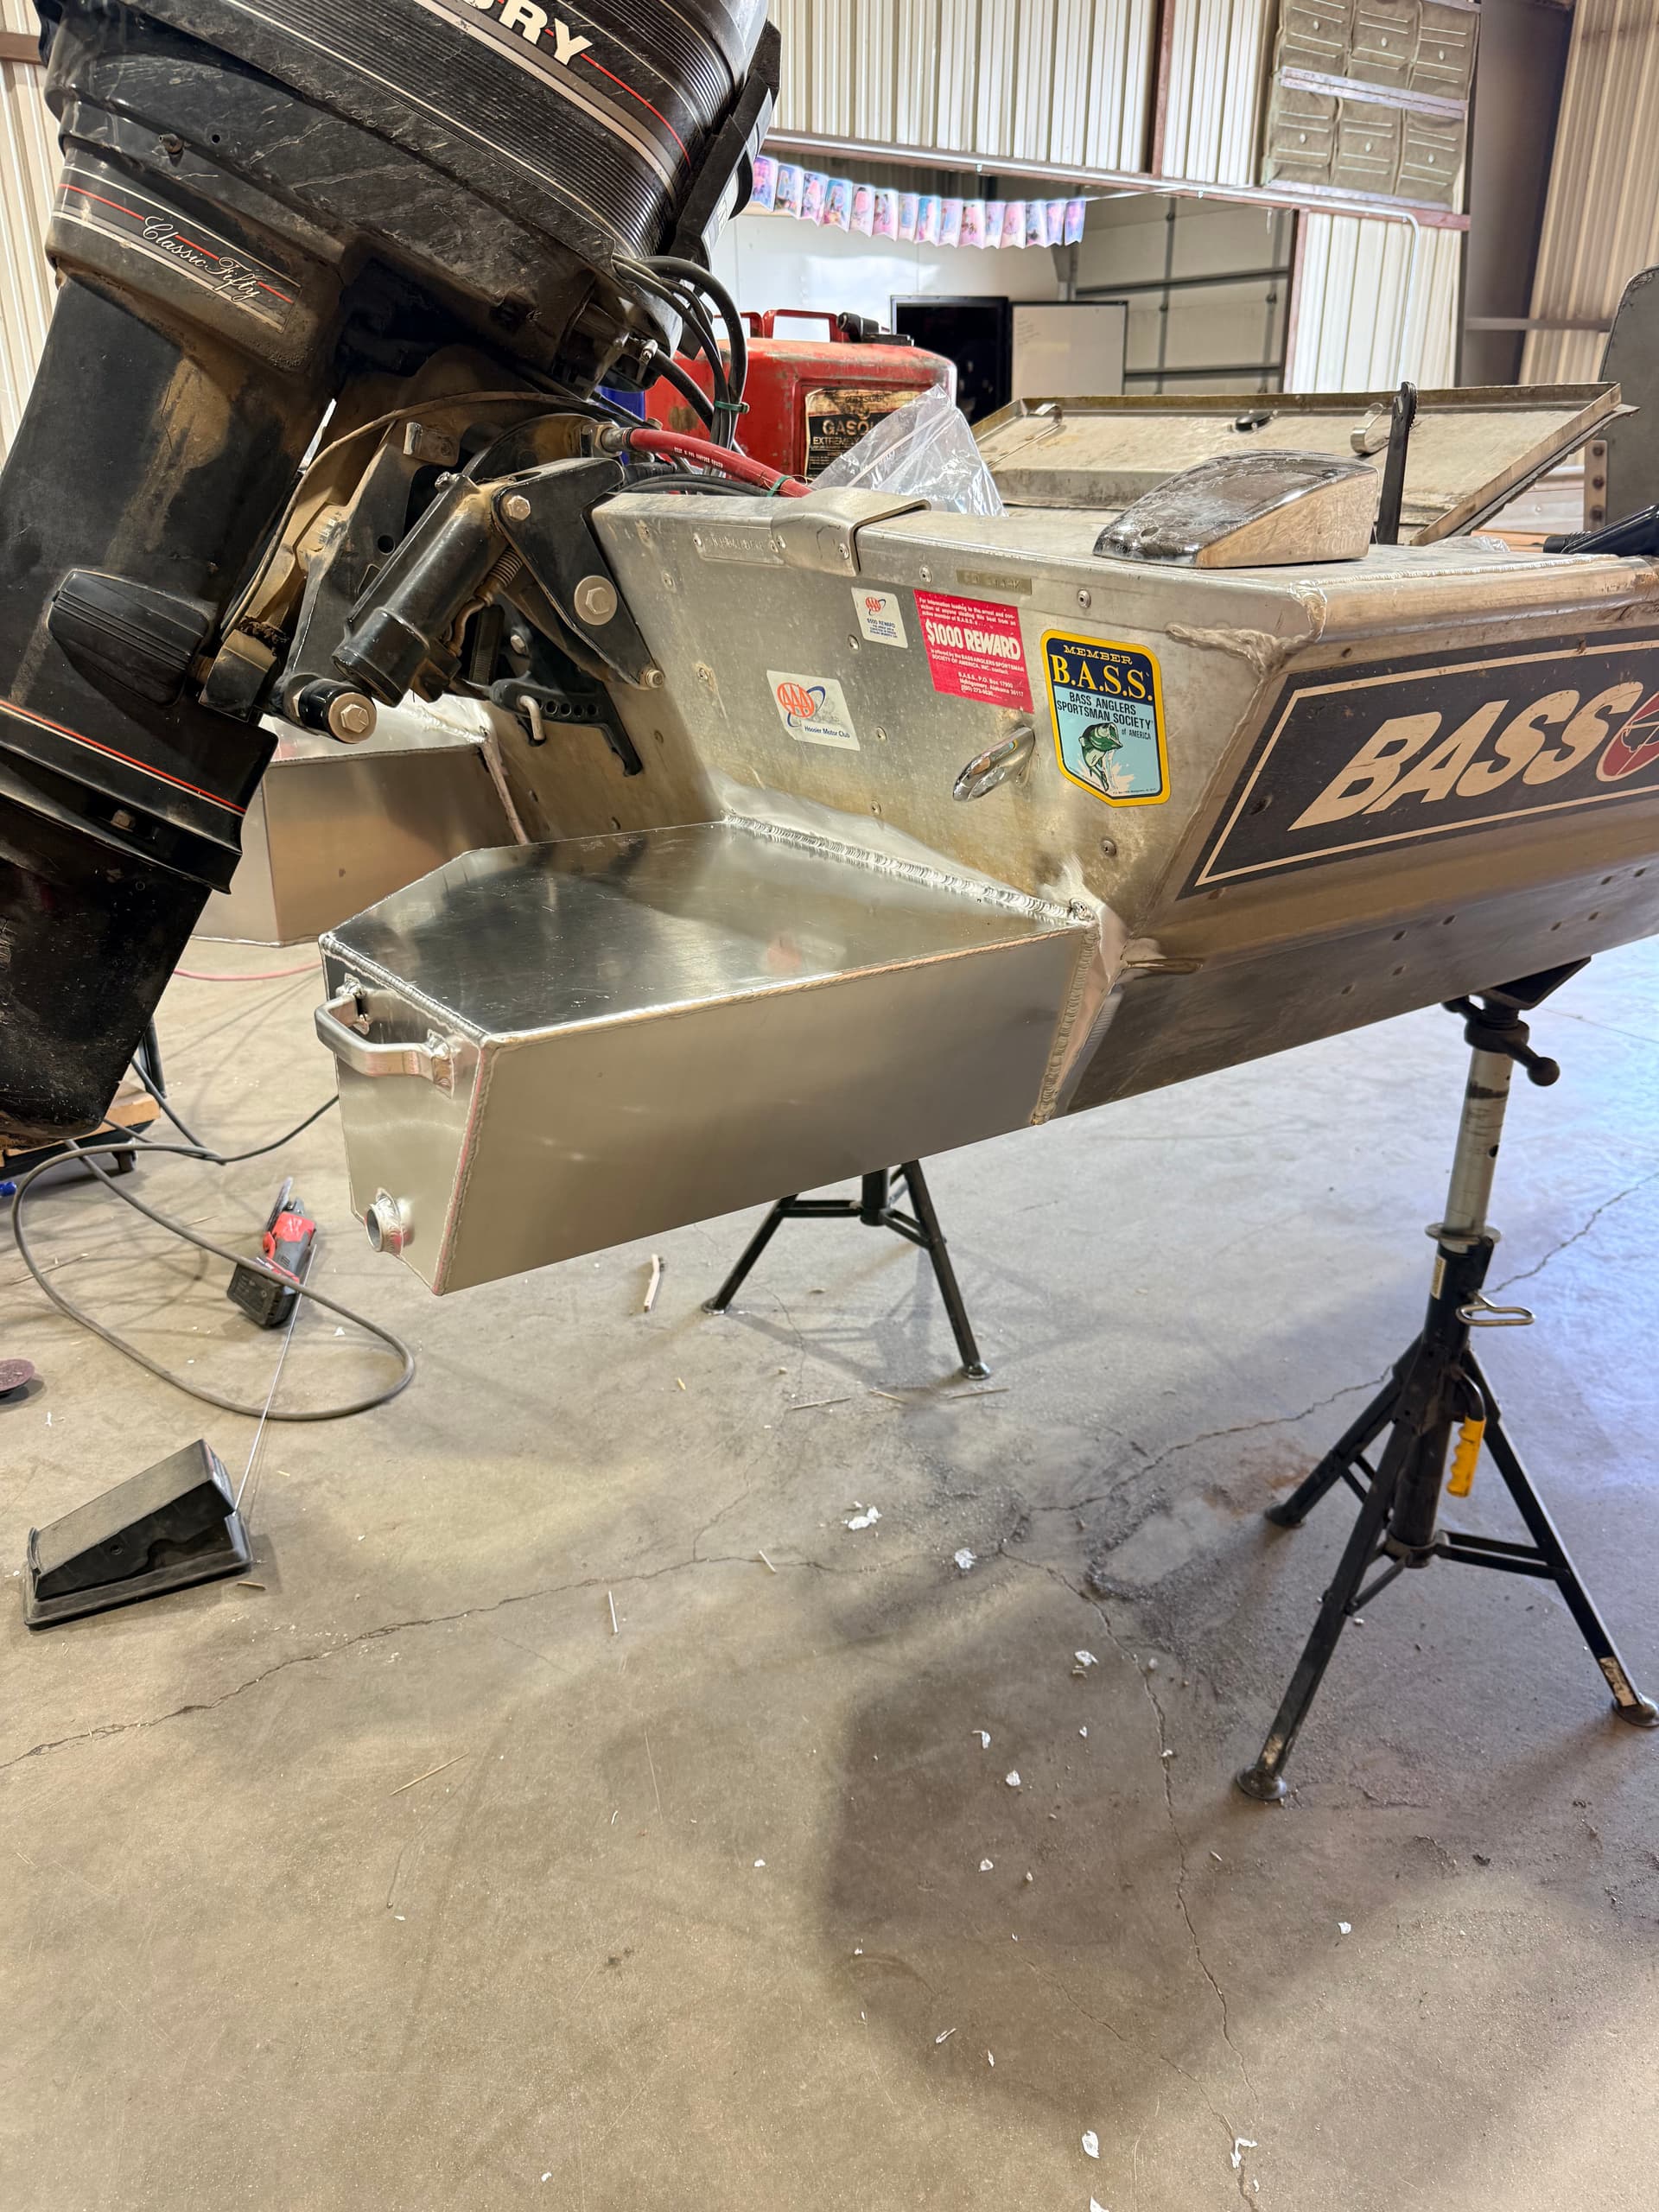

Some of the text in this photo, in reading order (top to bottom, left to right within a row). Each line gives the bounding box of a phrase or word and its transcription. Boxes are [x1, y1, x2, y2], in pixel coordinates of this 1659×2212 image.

[461, 0, 593, 66] RY
[143, 216, 261, 302] Classic Fifty
[950, 603, 966, 612] leading
[925, 618, 1021, 661] $1000 REWARD
[931, 654, 950, 663] SOCIETY
[973, 657, 995, 665] ANGLERS
[995, 661, 1024, 672] SPORTSMAN
[1063, 645, 1133, 664] MEMBER
[1049, 654, 1154, 702] B.A.S.S.
[779, 683, 813, 718] AAA
[1070, 692, 1136, 715] BASS ANGLERS
[1057, 700, 1152, 730] SPORTSMAN SOCIETY
[804, 725, 850, 739] Hoosier Motor Club
[1128, 729, 1152, 741] AMERICA
[1287, 681, 1643, 831] BASS
